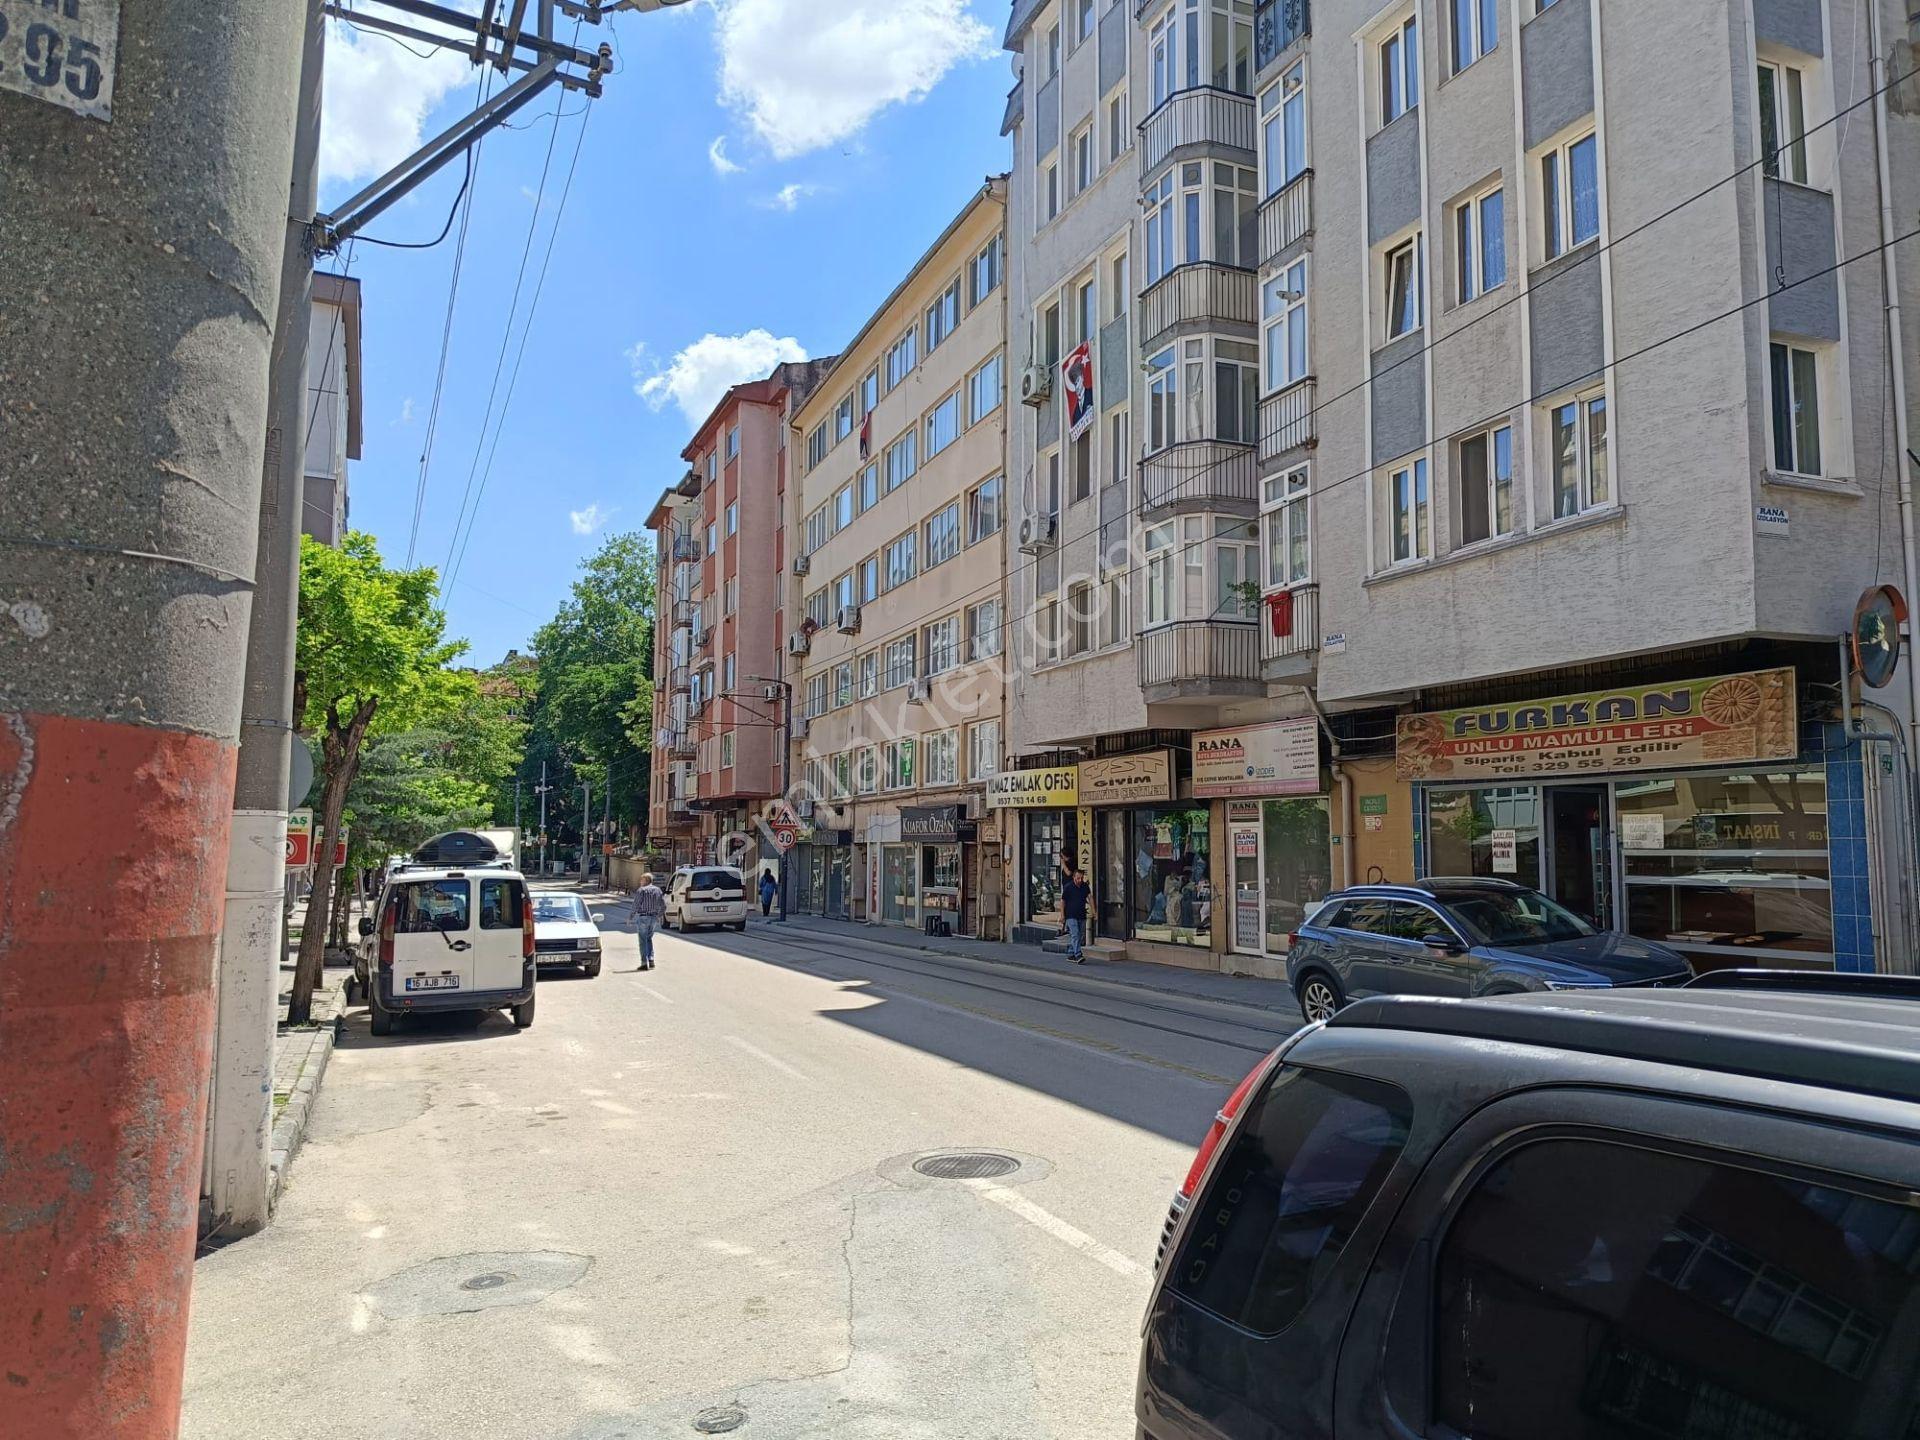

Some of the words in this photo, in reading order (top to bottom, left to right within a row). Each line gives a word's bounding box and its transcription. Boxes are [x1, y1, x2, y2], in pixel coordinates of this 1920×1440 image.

[0, 12, 101, 101] 95
[1760, 507, 1785, 517] RANA
[1453, 687, 1692, 737] FURKAN
[1198, 737, 1242, 752] RANA
[1454, 738, 1515, 755] UNLU
[1538, 747, 1601, 760] Kabul
[1616, 740, 1683, 755] Edilir
[1084, 755, 1164, 779] YST
[1491, 764, 1526, 774] Tel:
[1531, 761, 1569, 772] 329
[1577, 759, 1604, 770] 55
[1612, 755, 1642, 767] 29
[987, 776, 1009, 795] YILMAZ
[1010, 774, 1042, 793] EMLAK
[1026, 796, 1035, 804] 14
[779, 833, 792, 843] 30
[1080, 809, 1091, 865] YILMAZ
[412, 979, 420, 988] 16
[424, 978, 438, 987] AJB
[443, 977, 457, 986] 716
